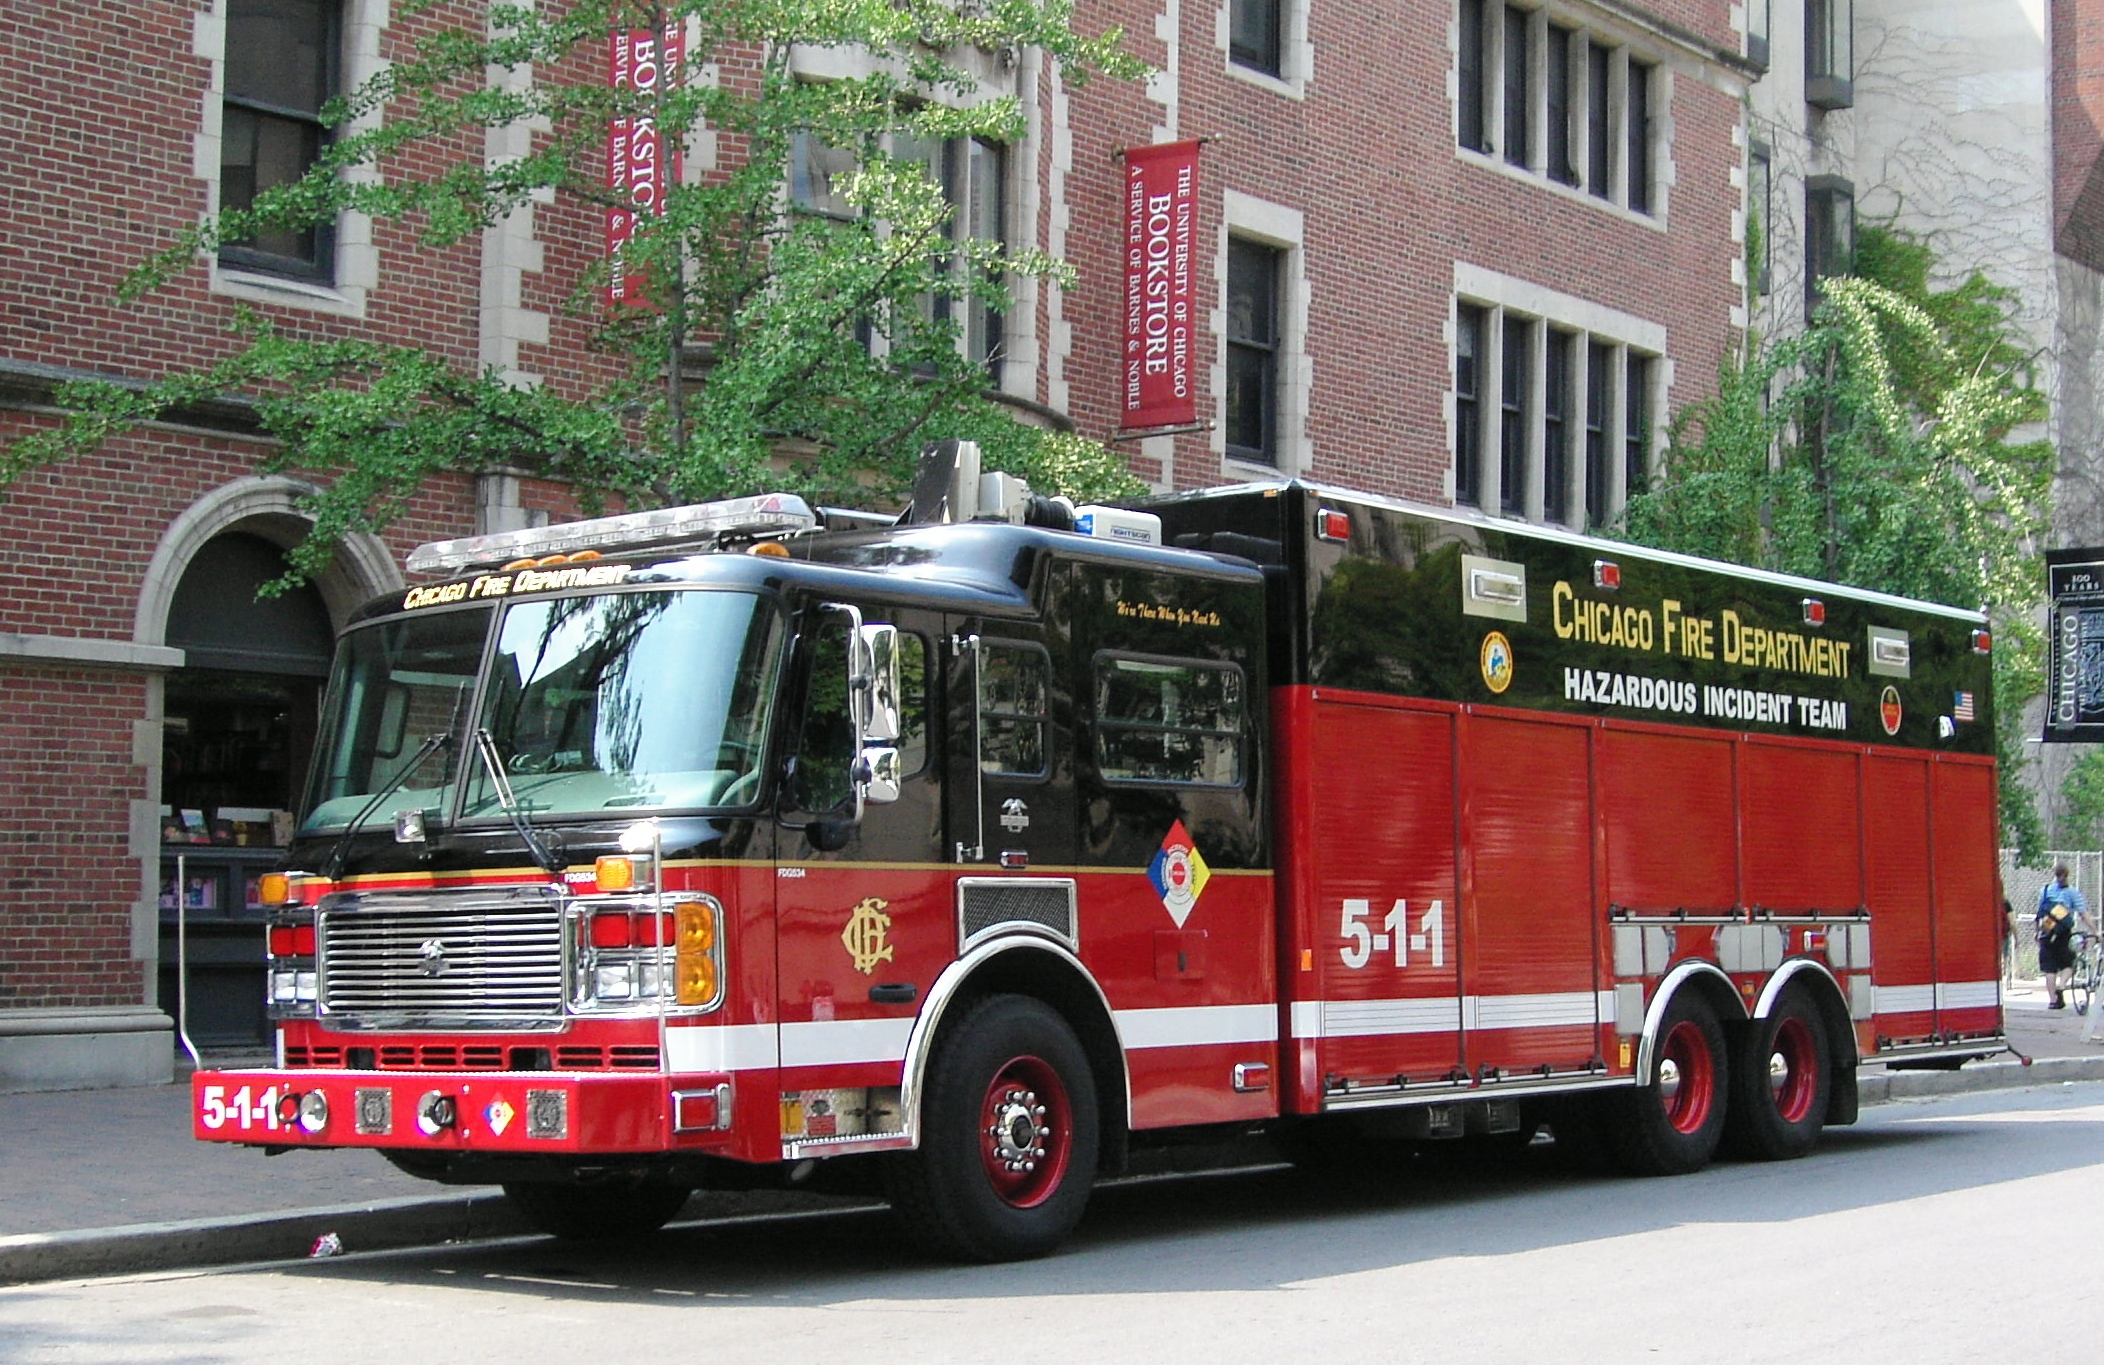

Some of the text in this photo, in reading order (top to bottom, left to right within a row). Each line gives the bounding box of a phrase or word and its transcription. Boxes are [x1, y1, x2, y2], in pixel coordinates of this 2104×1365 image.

[613, 136, 627, 204] BARN
[611, 214, 625, 231] &
[1127, 165, 1144, 410] A SERVICE OF BARNES & NOBLE
[1145, 192, 1171, 375] BOOKSTORE
[1173, 165, 1192, 398] THE UNIVERSITY OF CHICAGO
[403, 565, 631, 611] CHICAGO FIRE DEPARTMENT
[1553, 580, 1850, 678] CHICAGO FIRE DEPARTMENT
[1564, 667, 1847, 730] HAZARDOUS INCIDENT TEAM
[2060, 615, 2078, 721] CHICAGO
[1339, 899, 1443, 968] 5-1-1
[203, 1086, 278, 1129] 5-1-1
